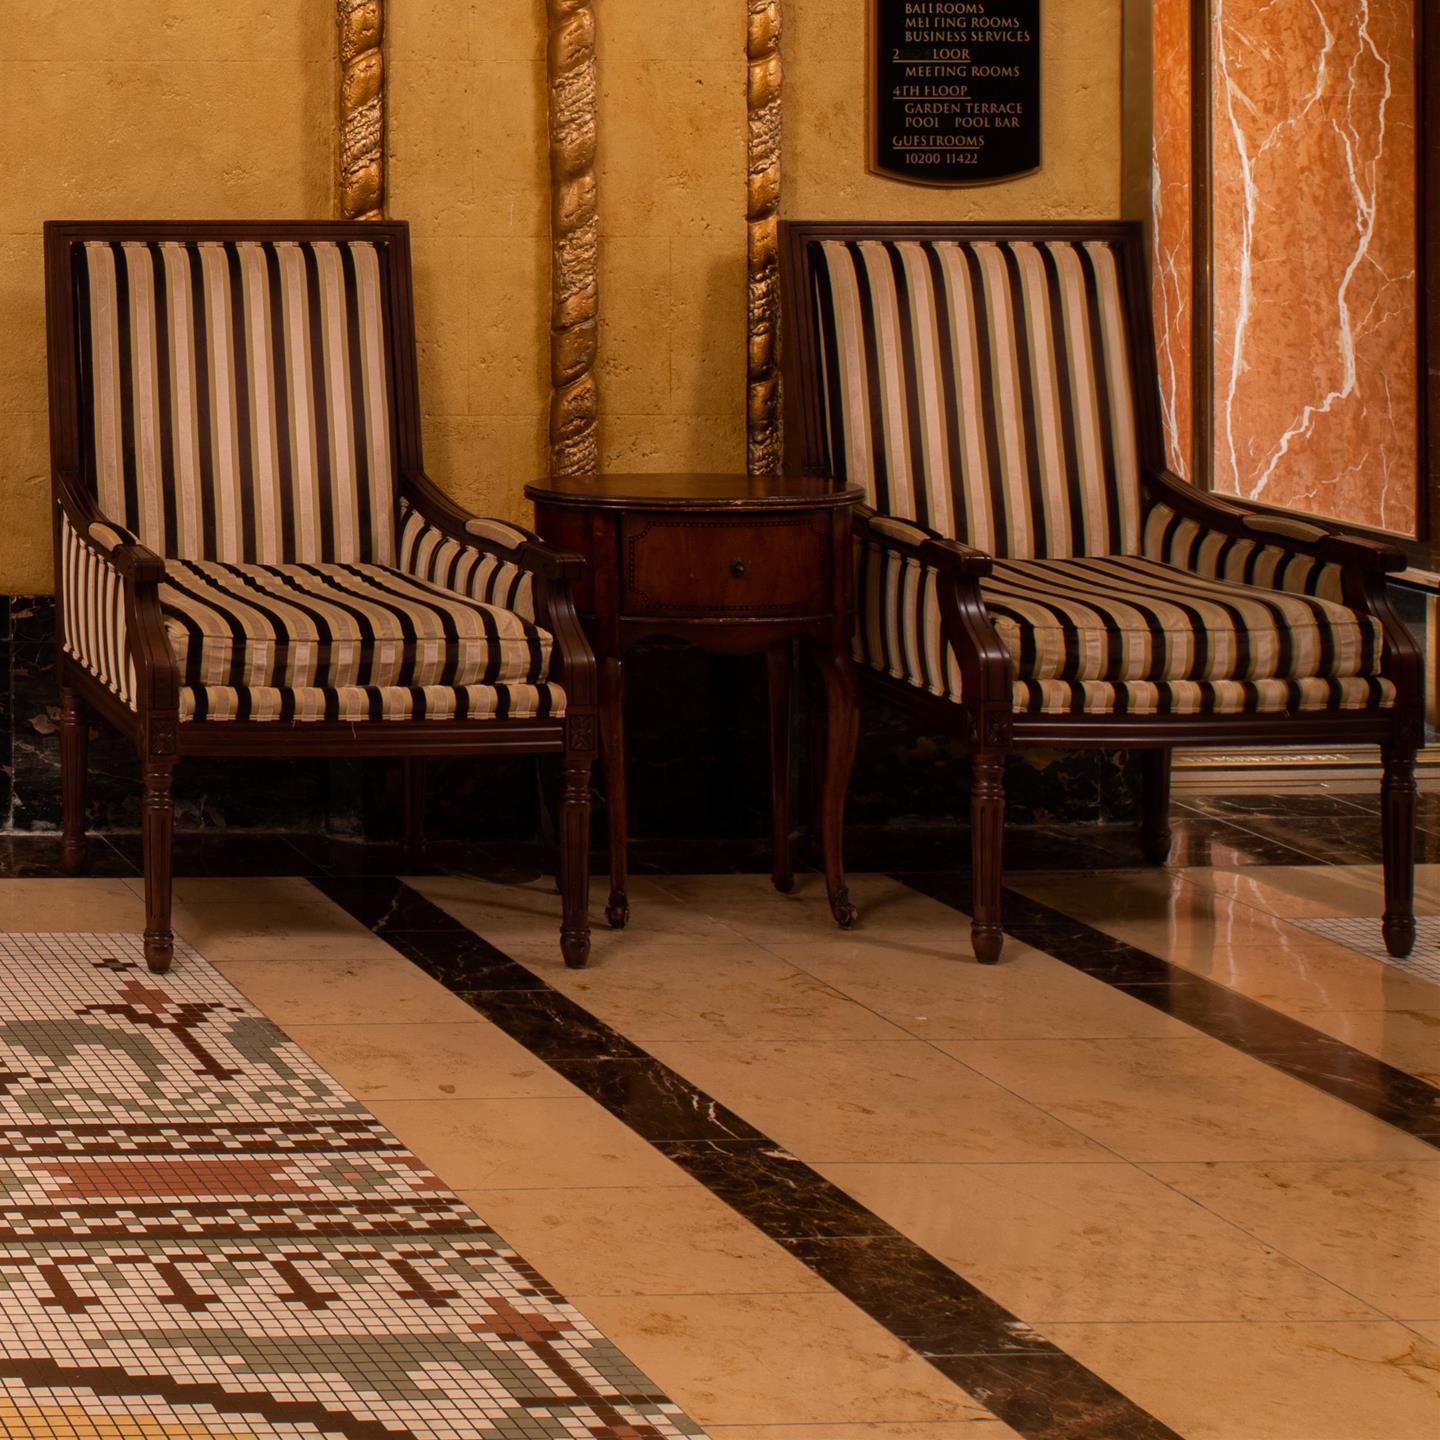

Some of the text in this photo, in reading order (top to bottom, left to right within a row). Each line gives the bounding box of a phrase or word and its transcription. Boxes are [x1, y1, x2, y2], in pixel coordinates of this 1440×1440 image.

[905, 3, 985, 14] BALLROOMS
[971, 17, 1020, 28] ROOMS
[905, 31, 1031, 42] BUSINESS SERVICES
[929, 48, 970, 59] LOOR
[905, 66, 1020, 77] MEETING ROOMS
[892, 85, 968, 96] 4TH FLOOR
[904, 103, 1023, 114] GARDEN TERRACE
[955, 117, 991, 128] POOL
[995, 117, 1020, 128] BAR
[892, 136, 985, 147] GUESTROOMS
[906, 153, 978, 164] 10200 11422
